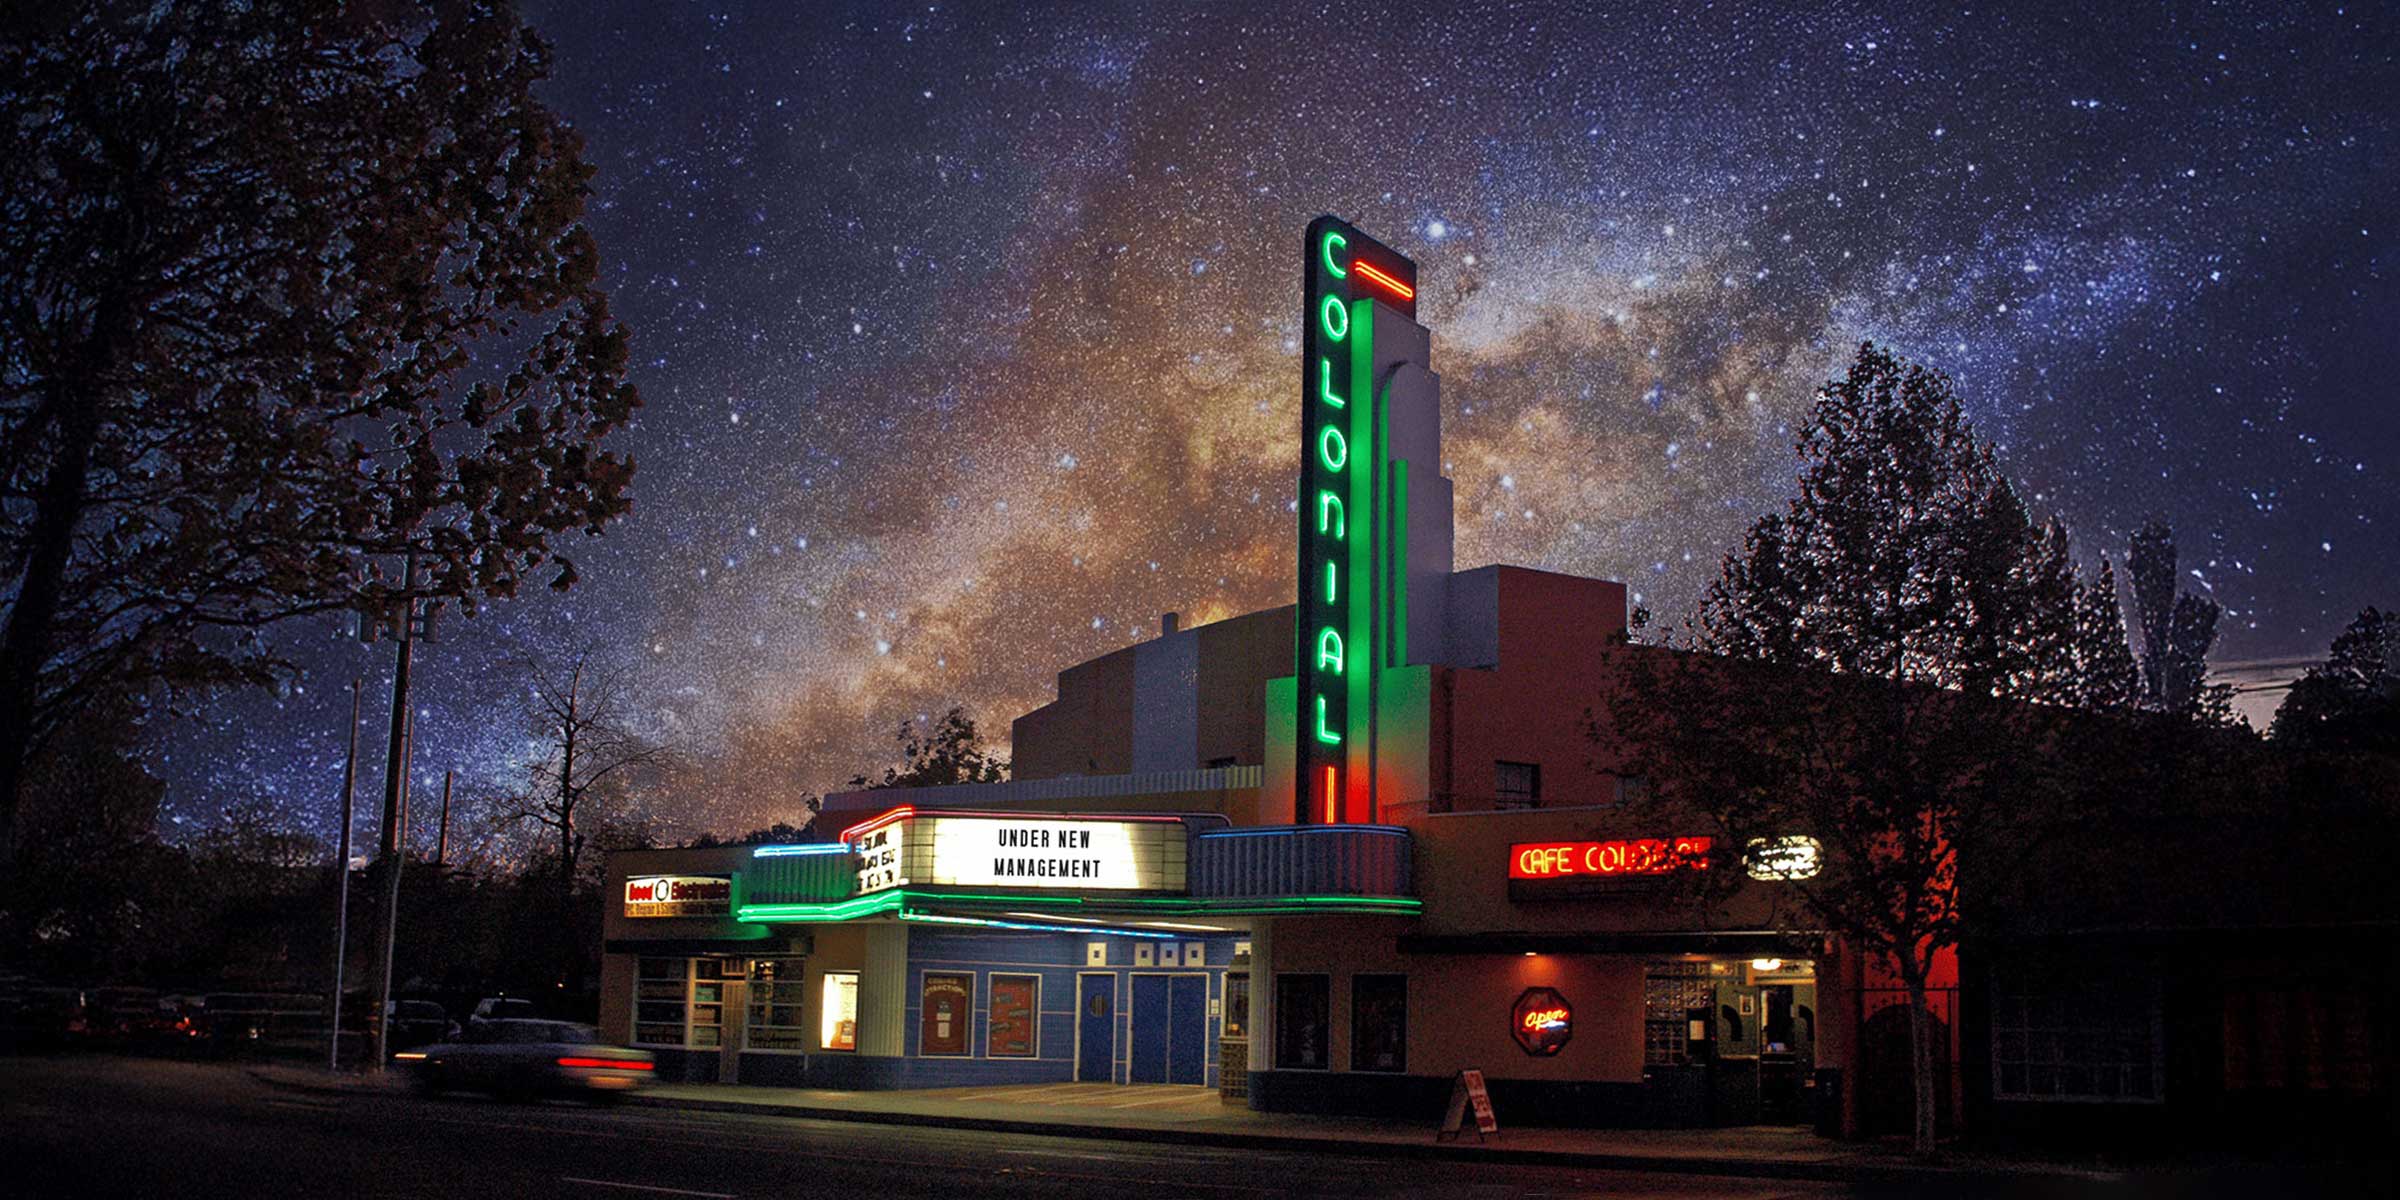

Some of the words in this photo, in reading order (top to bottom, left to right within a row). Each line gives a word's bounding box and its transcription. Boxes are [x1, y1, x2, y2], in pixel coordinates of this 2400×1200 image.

[1317, 231, 1349, 744] COLONIAL
[998, 828, 1050, 848] UNDER
[1058, 829, 1090, 849] NEW
[993, 857, 1101, 878] MANAGEMENT
[1519, 847, 1573, 874] CAFE
[1585, 841, 1707, 872] COLO
[1525, 1010, 1567, 1031] Open
